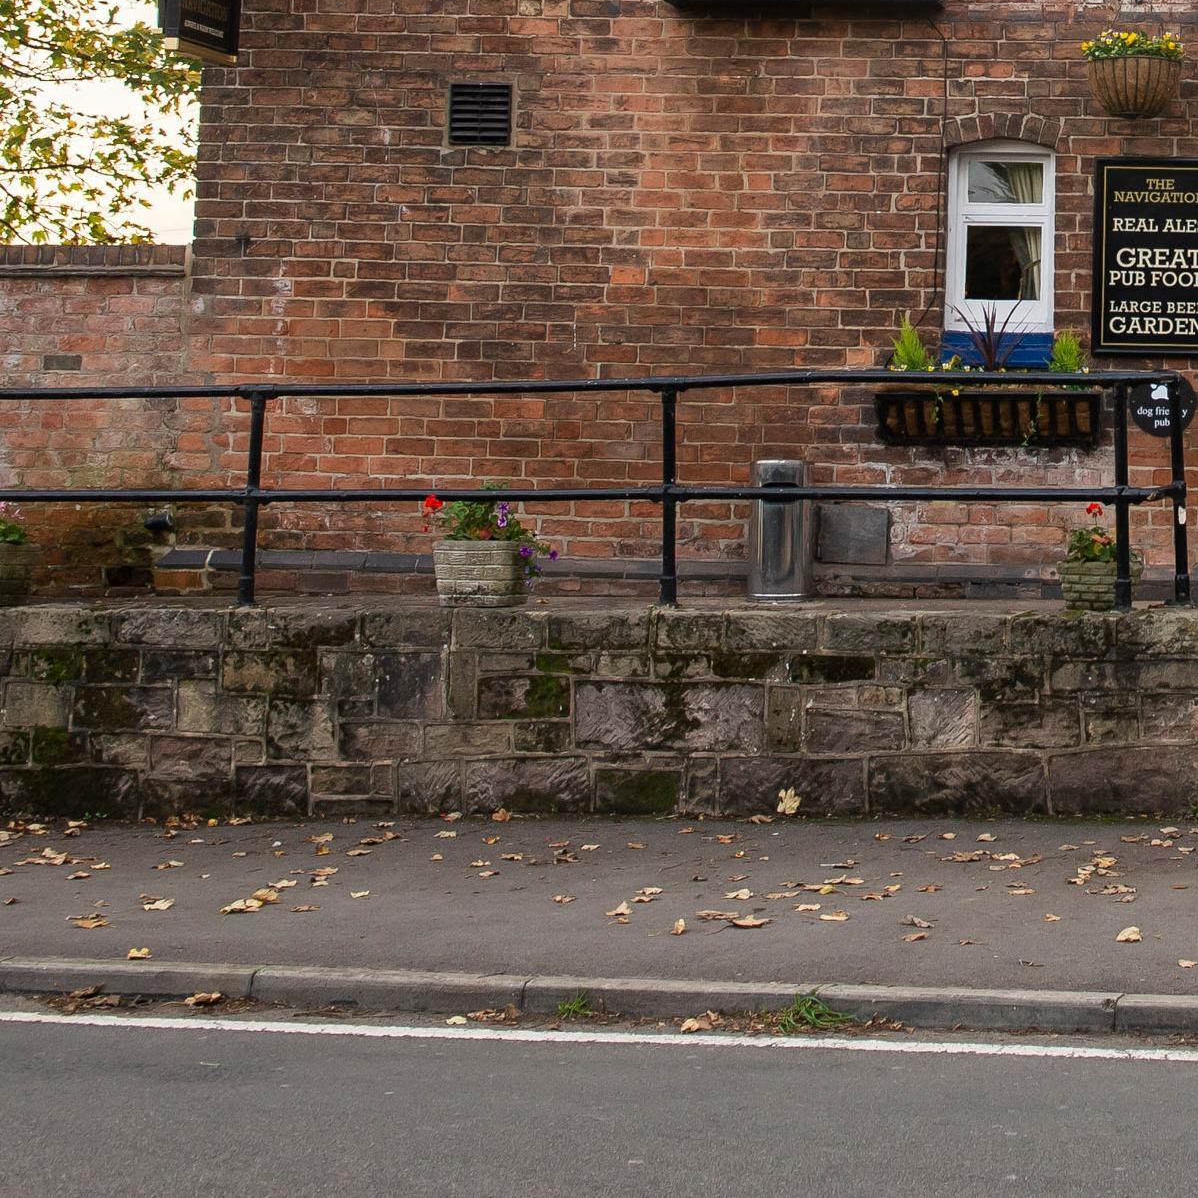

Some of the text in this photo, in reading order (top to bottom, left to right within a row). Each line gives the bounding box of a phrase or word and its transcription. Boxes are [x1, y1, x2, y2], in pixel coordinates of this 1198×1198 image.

[1146, 178, 1175, 190] THE
[1112, 218, 1158, 232] REAL
[1109, 271, 1146, 286] PUB
[1109, 301, 1162, 314] LARGE
[1137, 406, 1188, 418] dog friey
[1154, 418, 1171, 428] pub
